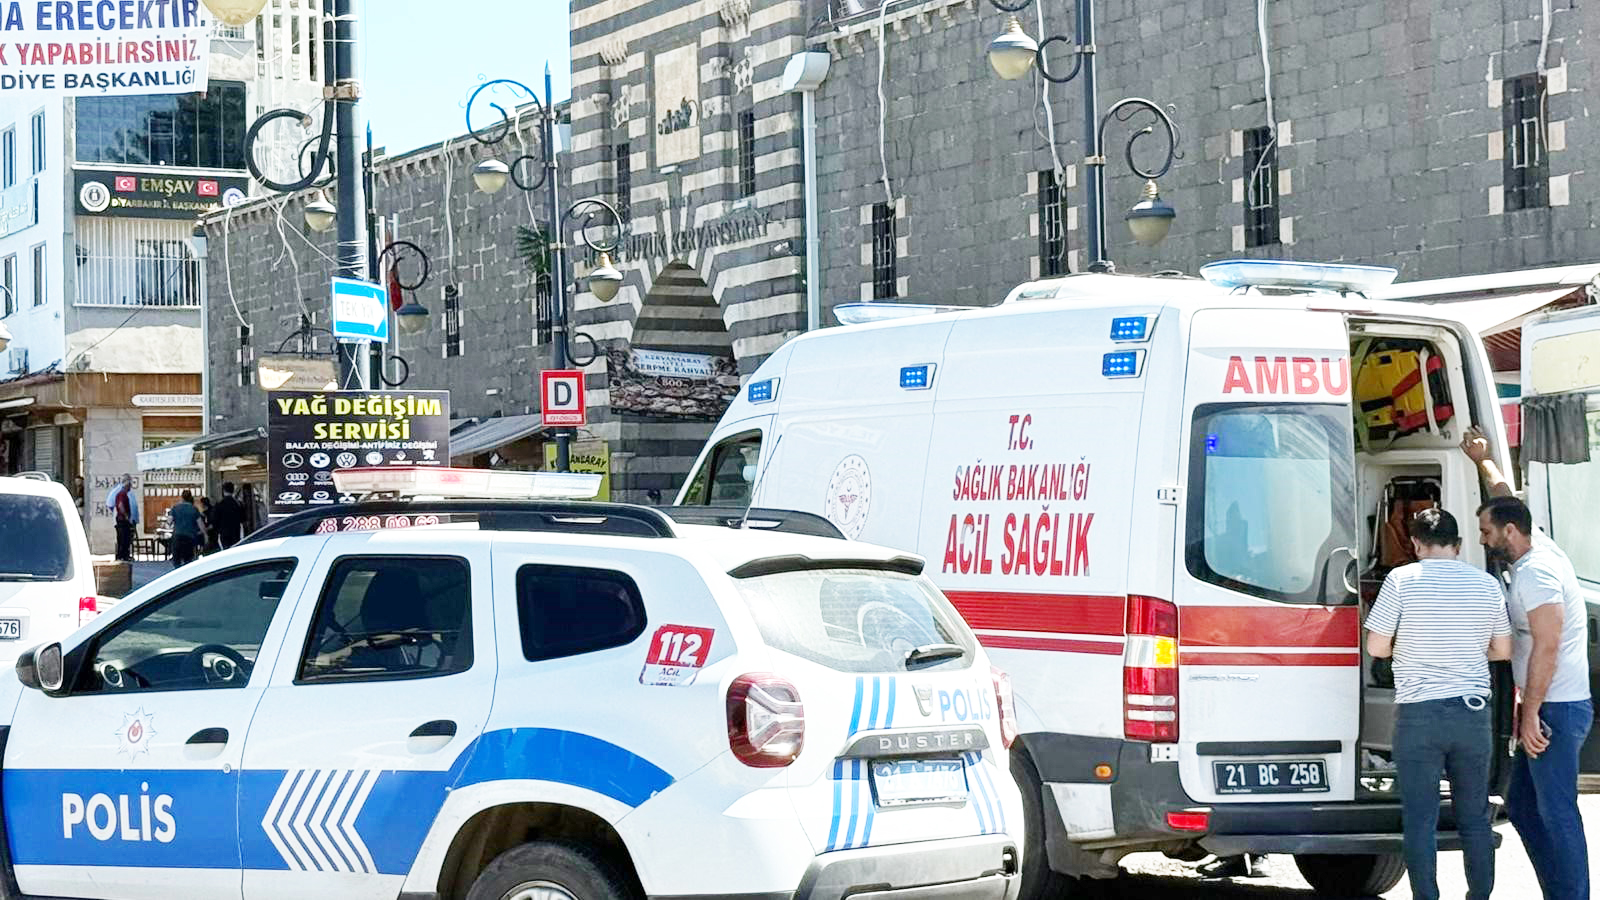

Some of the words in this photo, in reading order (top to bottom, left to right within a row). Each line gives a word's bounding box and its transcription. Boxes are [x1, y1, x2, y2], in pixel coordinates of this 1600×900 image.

[15, 34, 201, 65] YAPABİLİRSİNİZ.
[64, 66, 195, 93] BAŞKANLIĞI
[141, 178, 195, 197] EMŞAV
[671, 212, 769, 255] KERVANSARAY
[1222, 355, 1349, 396] AMBU
[554, 381, 572, 406] D
[277, 395, 328, 415] YAĞ
[334, 395, 442, 420] DEĞİŞİM
[313, 419, 410, 440] SERVİSİ
[1008, 414, 1034, 451] T.C.
[285, 442, 320, 450] BALATA
[953, 458, 1004, 501] SAĞLIK
[1006, 455, 1091, 501] BAKANLIĞI
[1001, 504, 1095, 577] SAĞLIK
[0, 621, 18, 635] 76
[658, 631, 703, 665] 112
[879, 735, 974, 750] DUSTER
[1225, 764, 1246, 787] 21
[1258, 764, 1279, 786] BC
[1289, 763, 1320, 785] 258
[62, 781, 176, 843] POLİS
